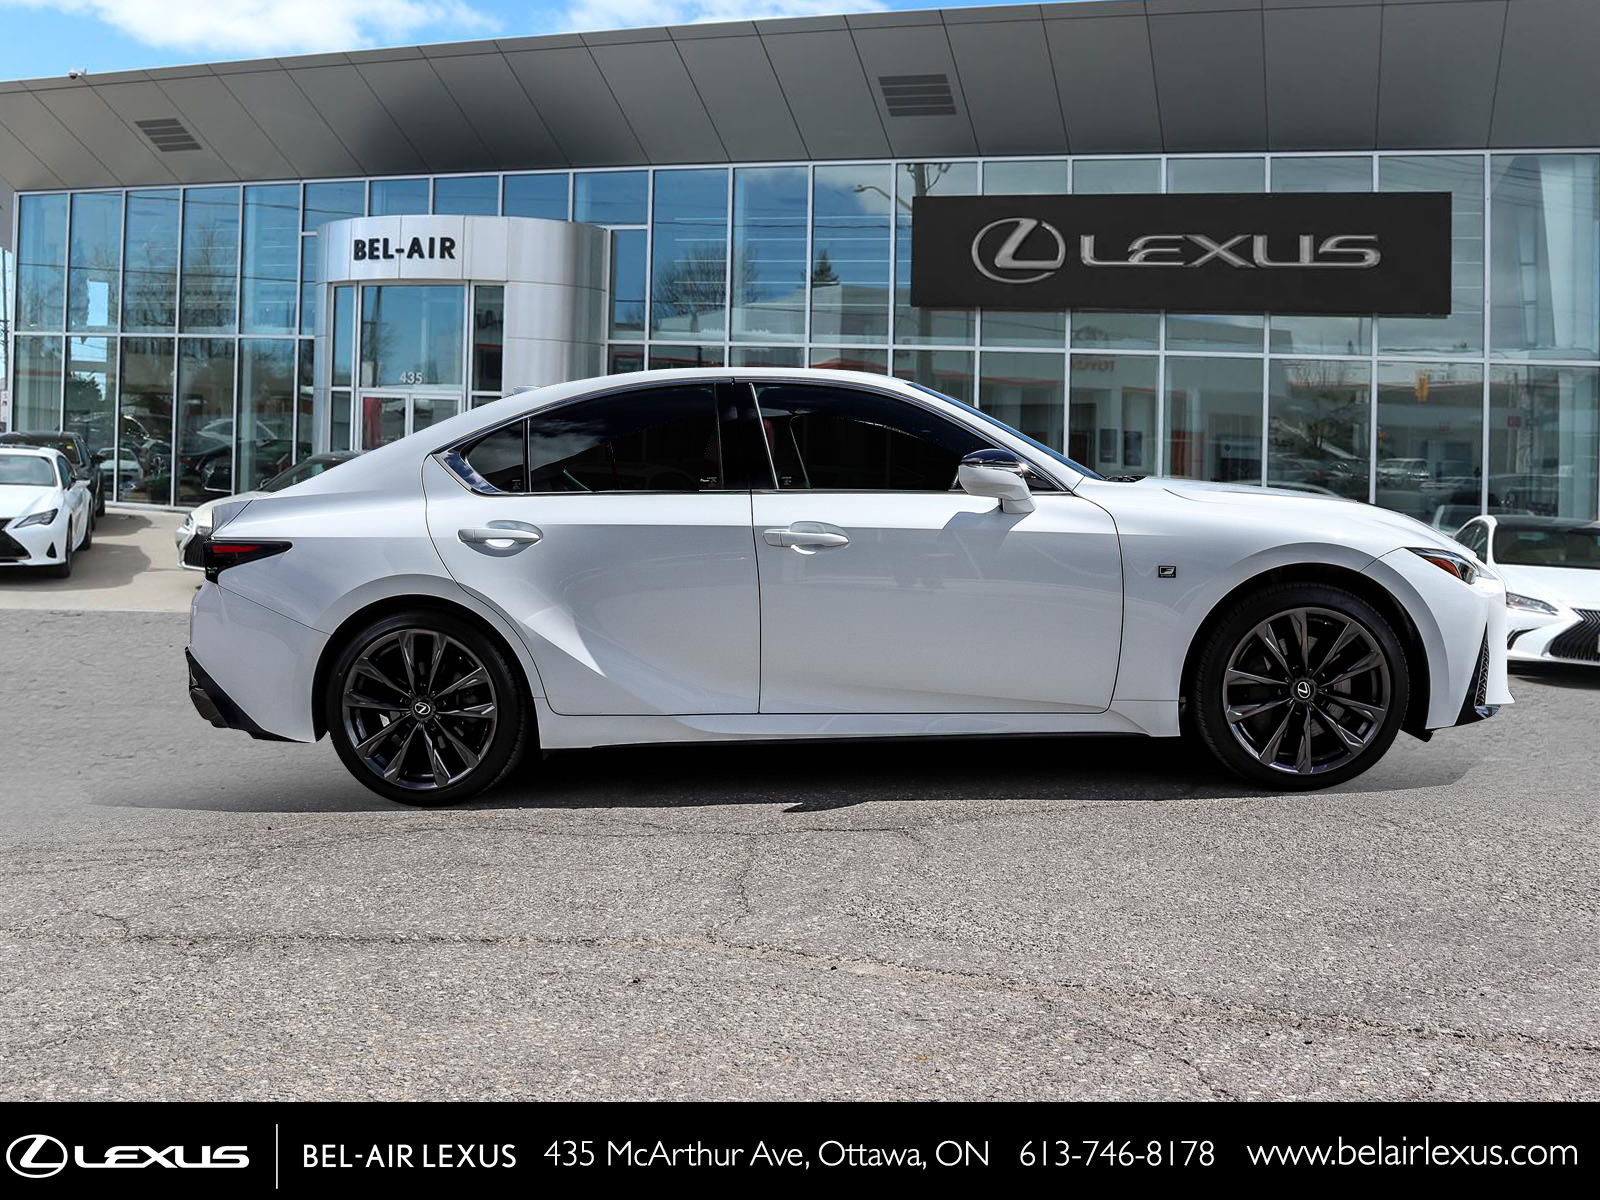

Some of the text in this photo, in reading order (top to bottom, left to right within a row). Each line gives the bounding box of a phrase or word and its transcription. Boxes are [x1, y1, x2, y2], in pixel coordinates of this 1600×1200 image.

[353, 236, 456, 261] BEL-AIR
[1080, 233, 1382, 269] LEXUS
[400, 371, 423, 385] 435
